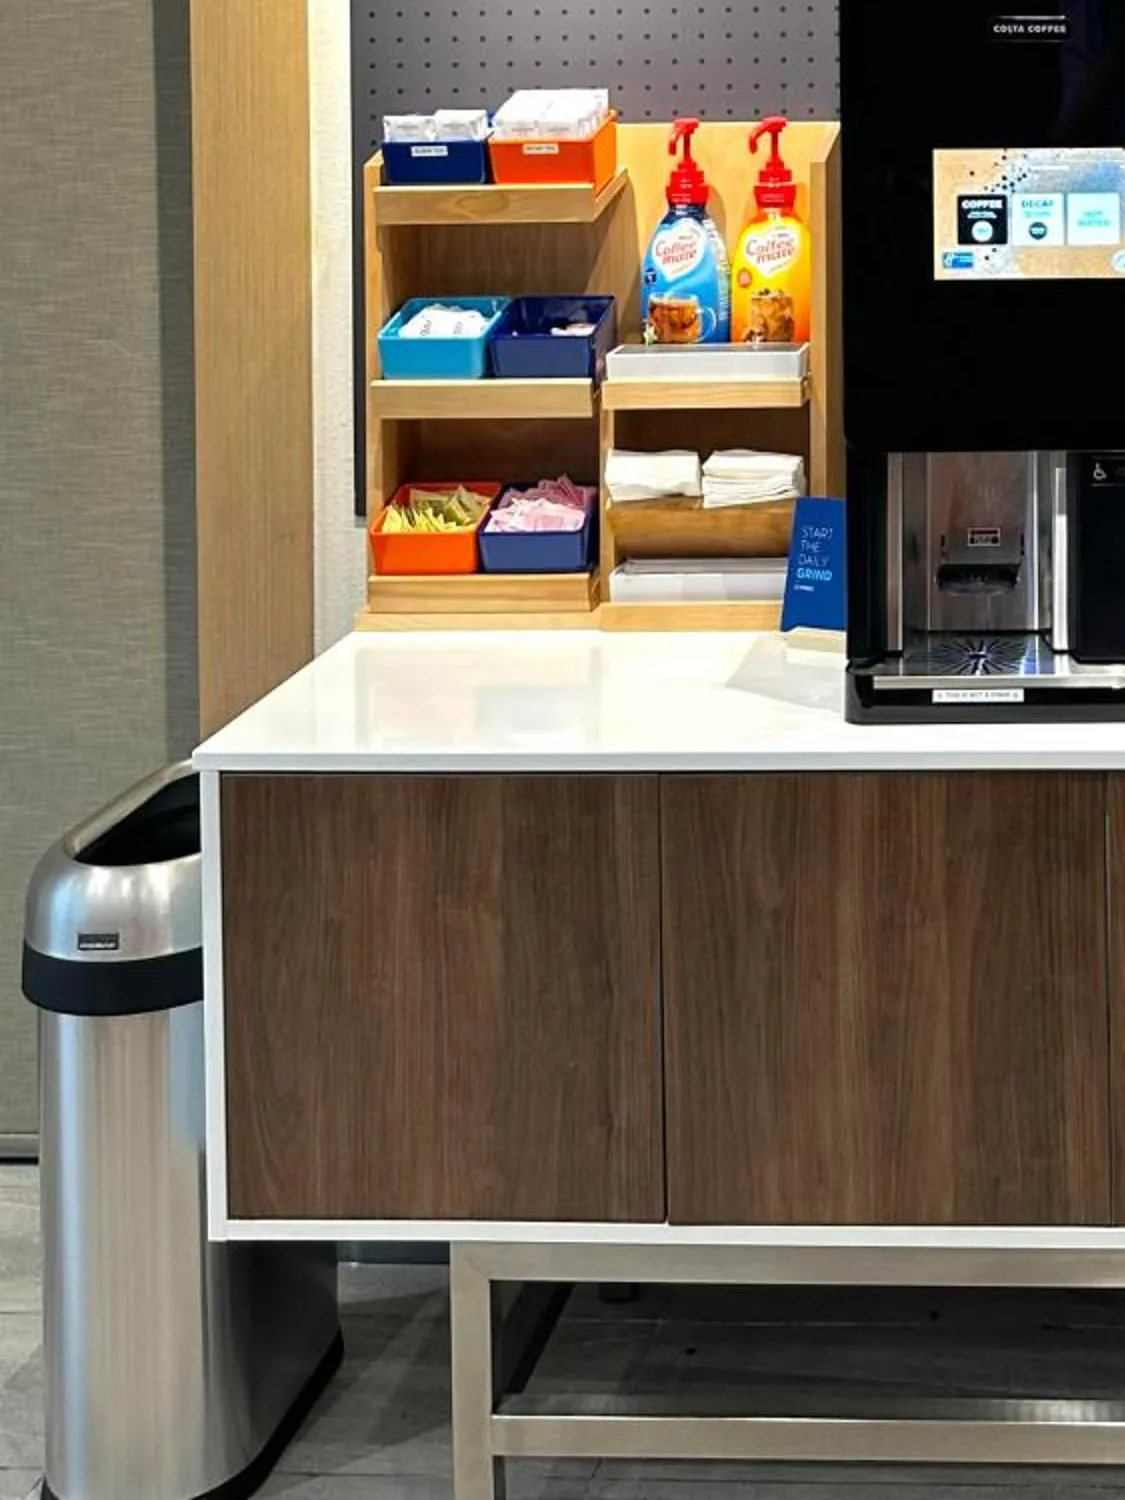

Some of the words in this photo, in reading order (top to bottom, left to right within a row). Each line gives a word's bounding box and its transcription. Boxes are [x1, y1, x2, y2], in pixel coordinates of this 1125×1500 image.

[993, 24, 1025, 34] COSTA
[1027, 24, 1067, 33] COFFEE
[801, 539, 822, 553] THE
[799, 553, 829, 567] DAILY
[797, 567, 833, 581] GRIND
